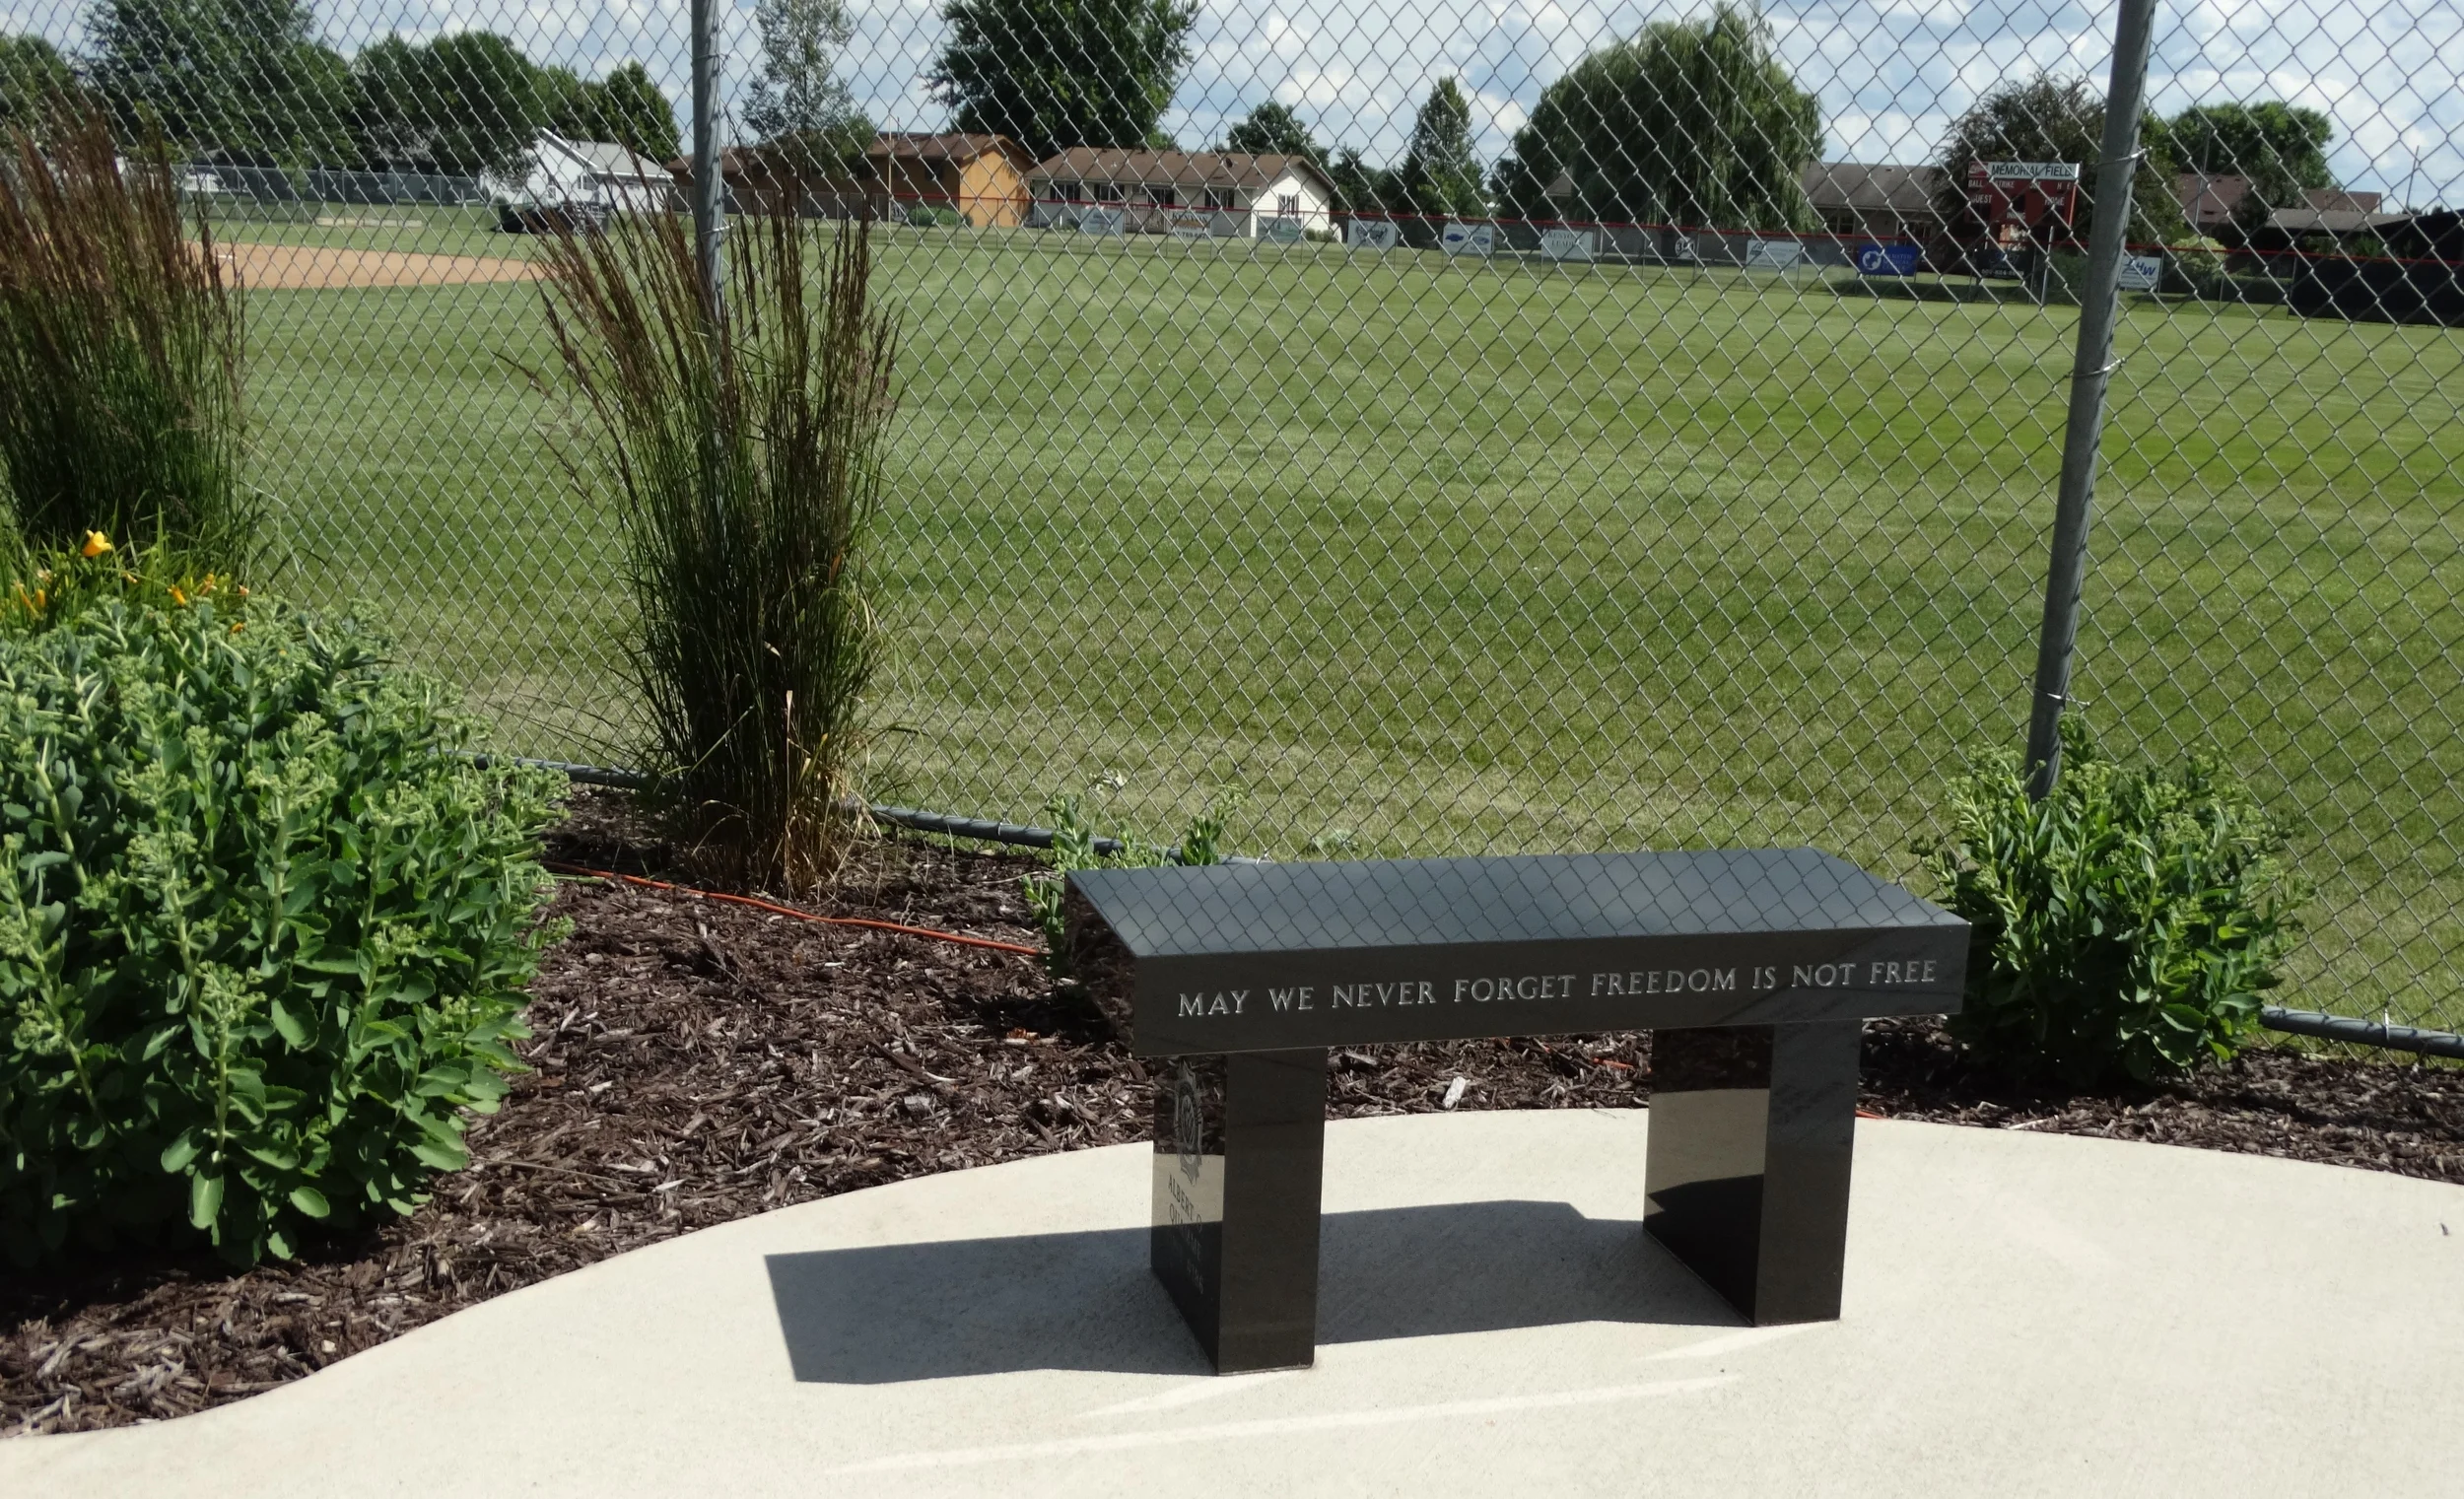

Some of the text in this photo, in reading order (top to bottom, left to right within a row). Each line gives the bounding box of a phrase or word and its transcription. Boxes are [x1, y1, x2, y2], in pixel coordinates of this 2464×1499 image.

[1991, 165, 2039, 176] MEMORIAL
[2045, 166, 2072, 177] FIELD
[1178, 960, 1937, 1017] MAY WE NEVER FORGET FREEDOM IS NOT FREE
[1168, 1174, 1195, 1221] ALBERT
